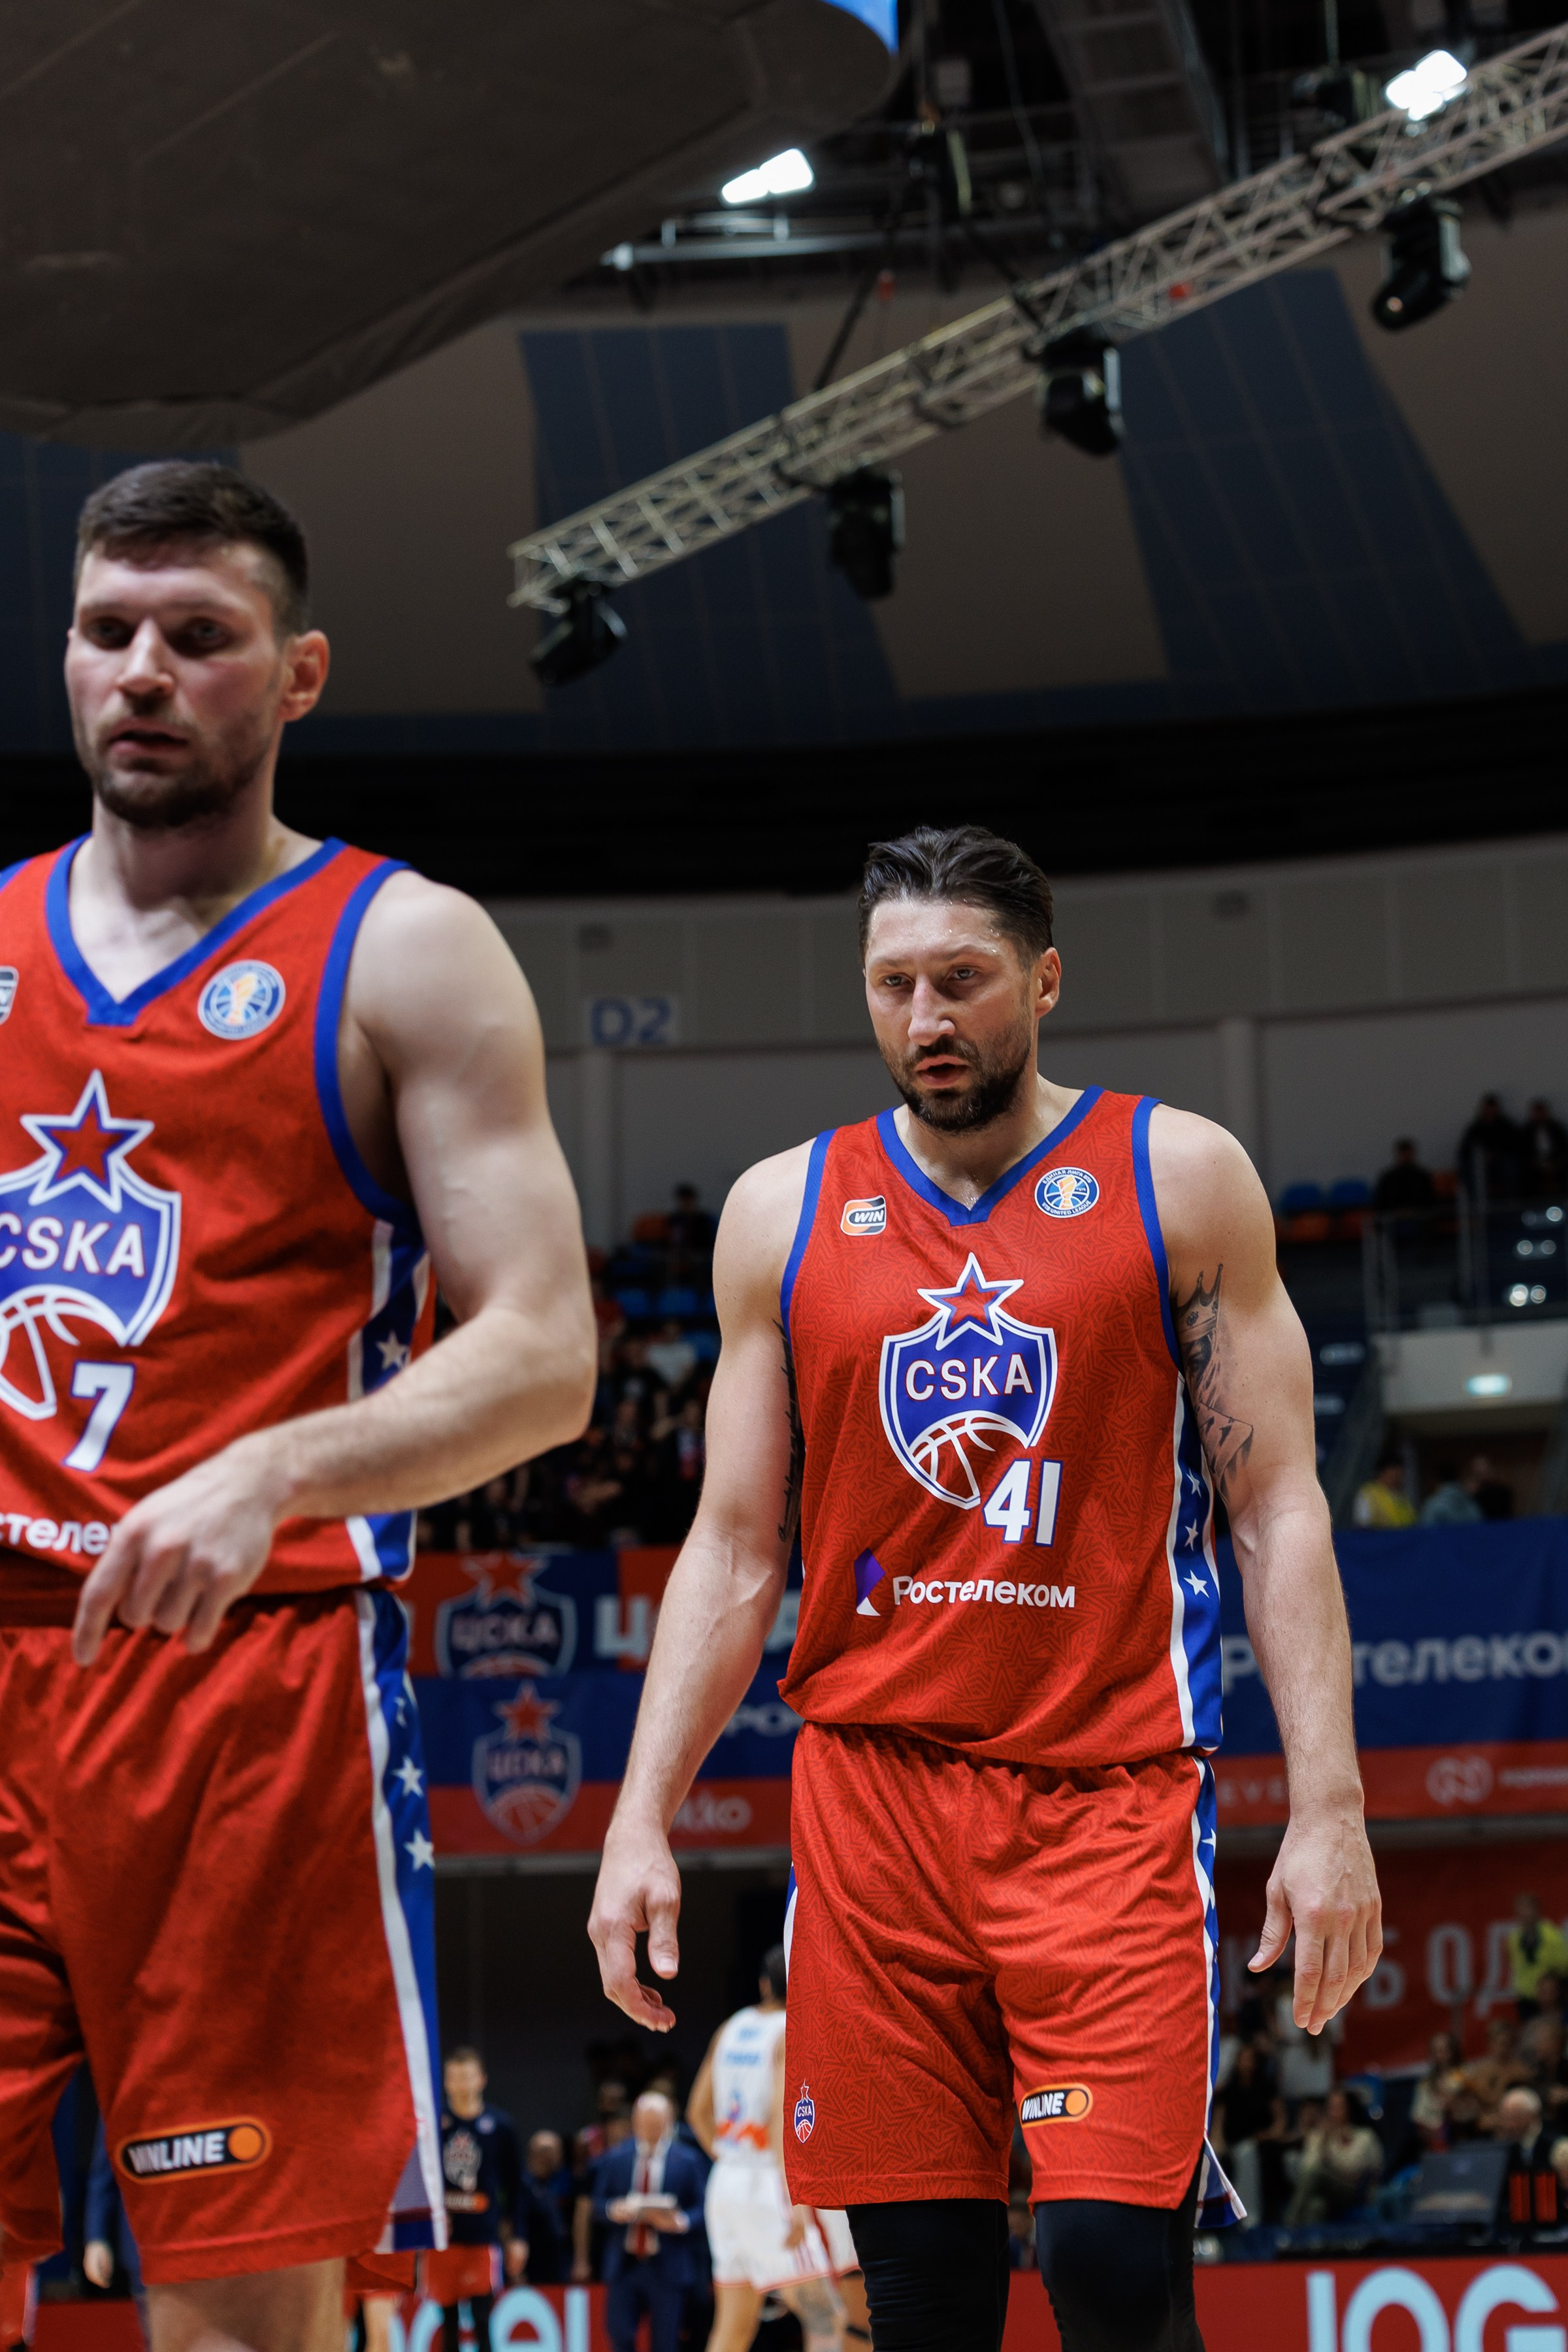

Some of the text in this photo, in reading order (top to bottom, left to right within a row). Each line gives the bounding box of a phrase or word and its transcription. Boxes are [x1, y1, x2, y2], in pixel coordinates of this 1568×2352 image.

[591, 996, 671, 1047] D2
[854, 1209, 884, 1223] WIN
[905, 1353, 1034, 1401] CSKA
[60, 1360, 135, 1473] 7
[983, 1459, 1063, 1547] 41
[892, 1575, 1075, 1608] Ростелеком
[797, 2104, 813, 2117] CSKA
